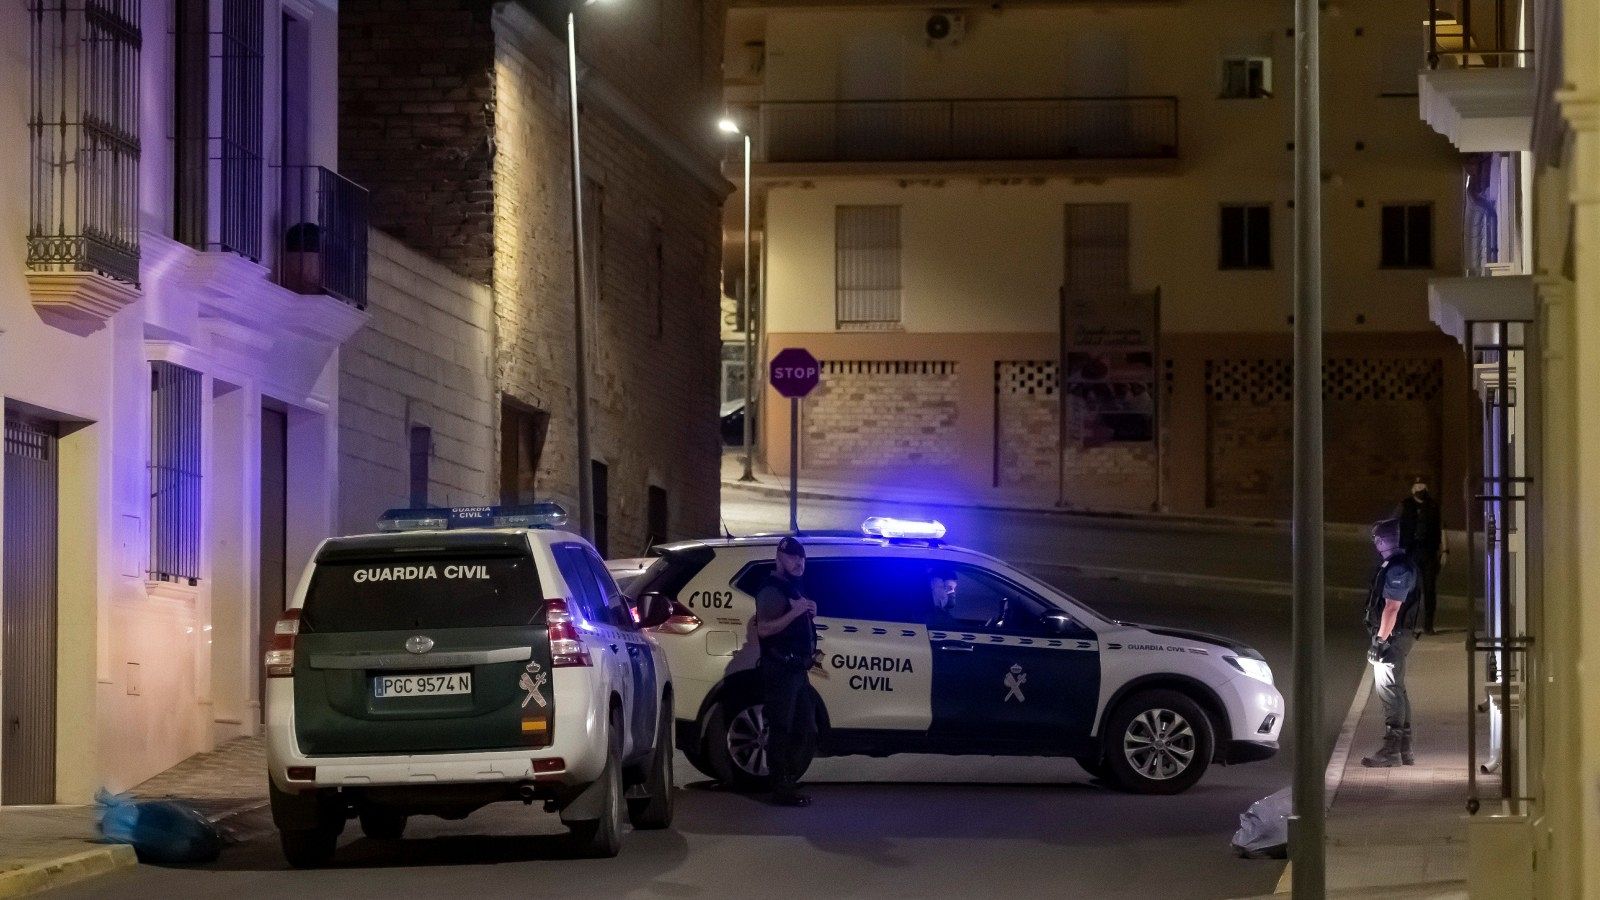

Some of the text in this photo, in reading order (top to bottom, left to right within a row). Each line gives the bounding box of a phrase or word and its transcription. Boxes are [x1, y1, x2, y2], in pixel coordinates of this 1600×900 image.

[774, 367, 816, 379] STOP
[353, 565, 490, 583] GUARDIA CIVIL
[702, 591, 733, 609] 062
[1127, 643, 1164, 652] GUARDIA
[831, 654, 914, 673] GUARDIA
[384, 675, 469, 694] PGC 9574 N
[849, 675, 893, 692] CIVIL
